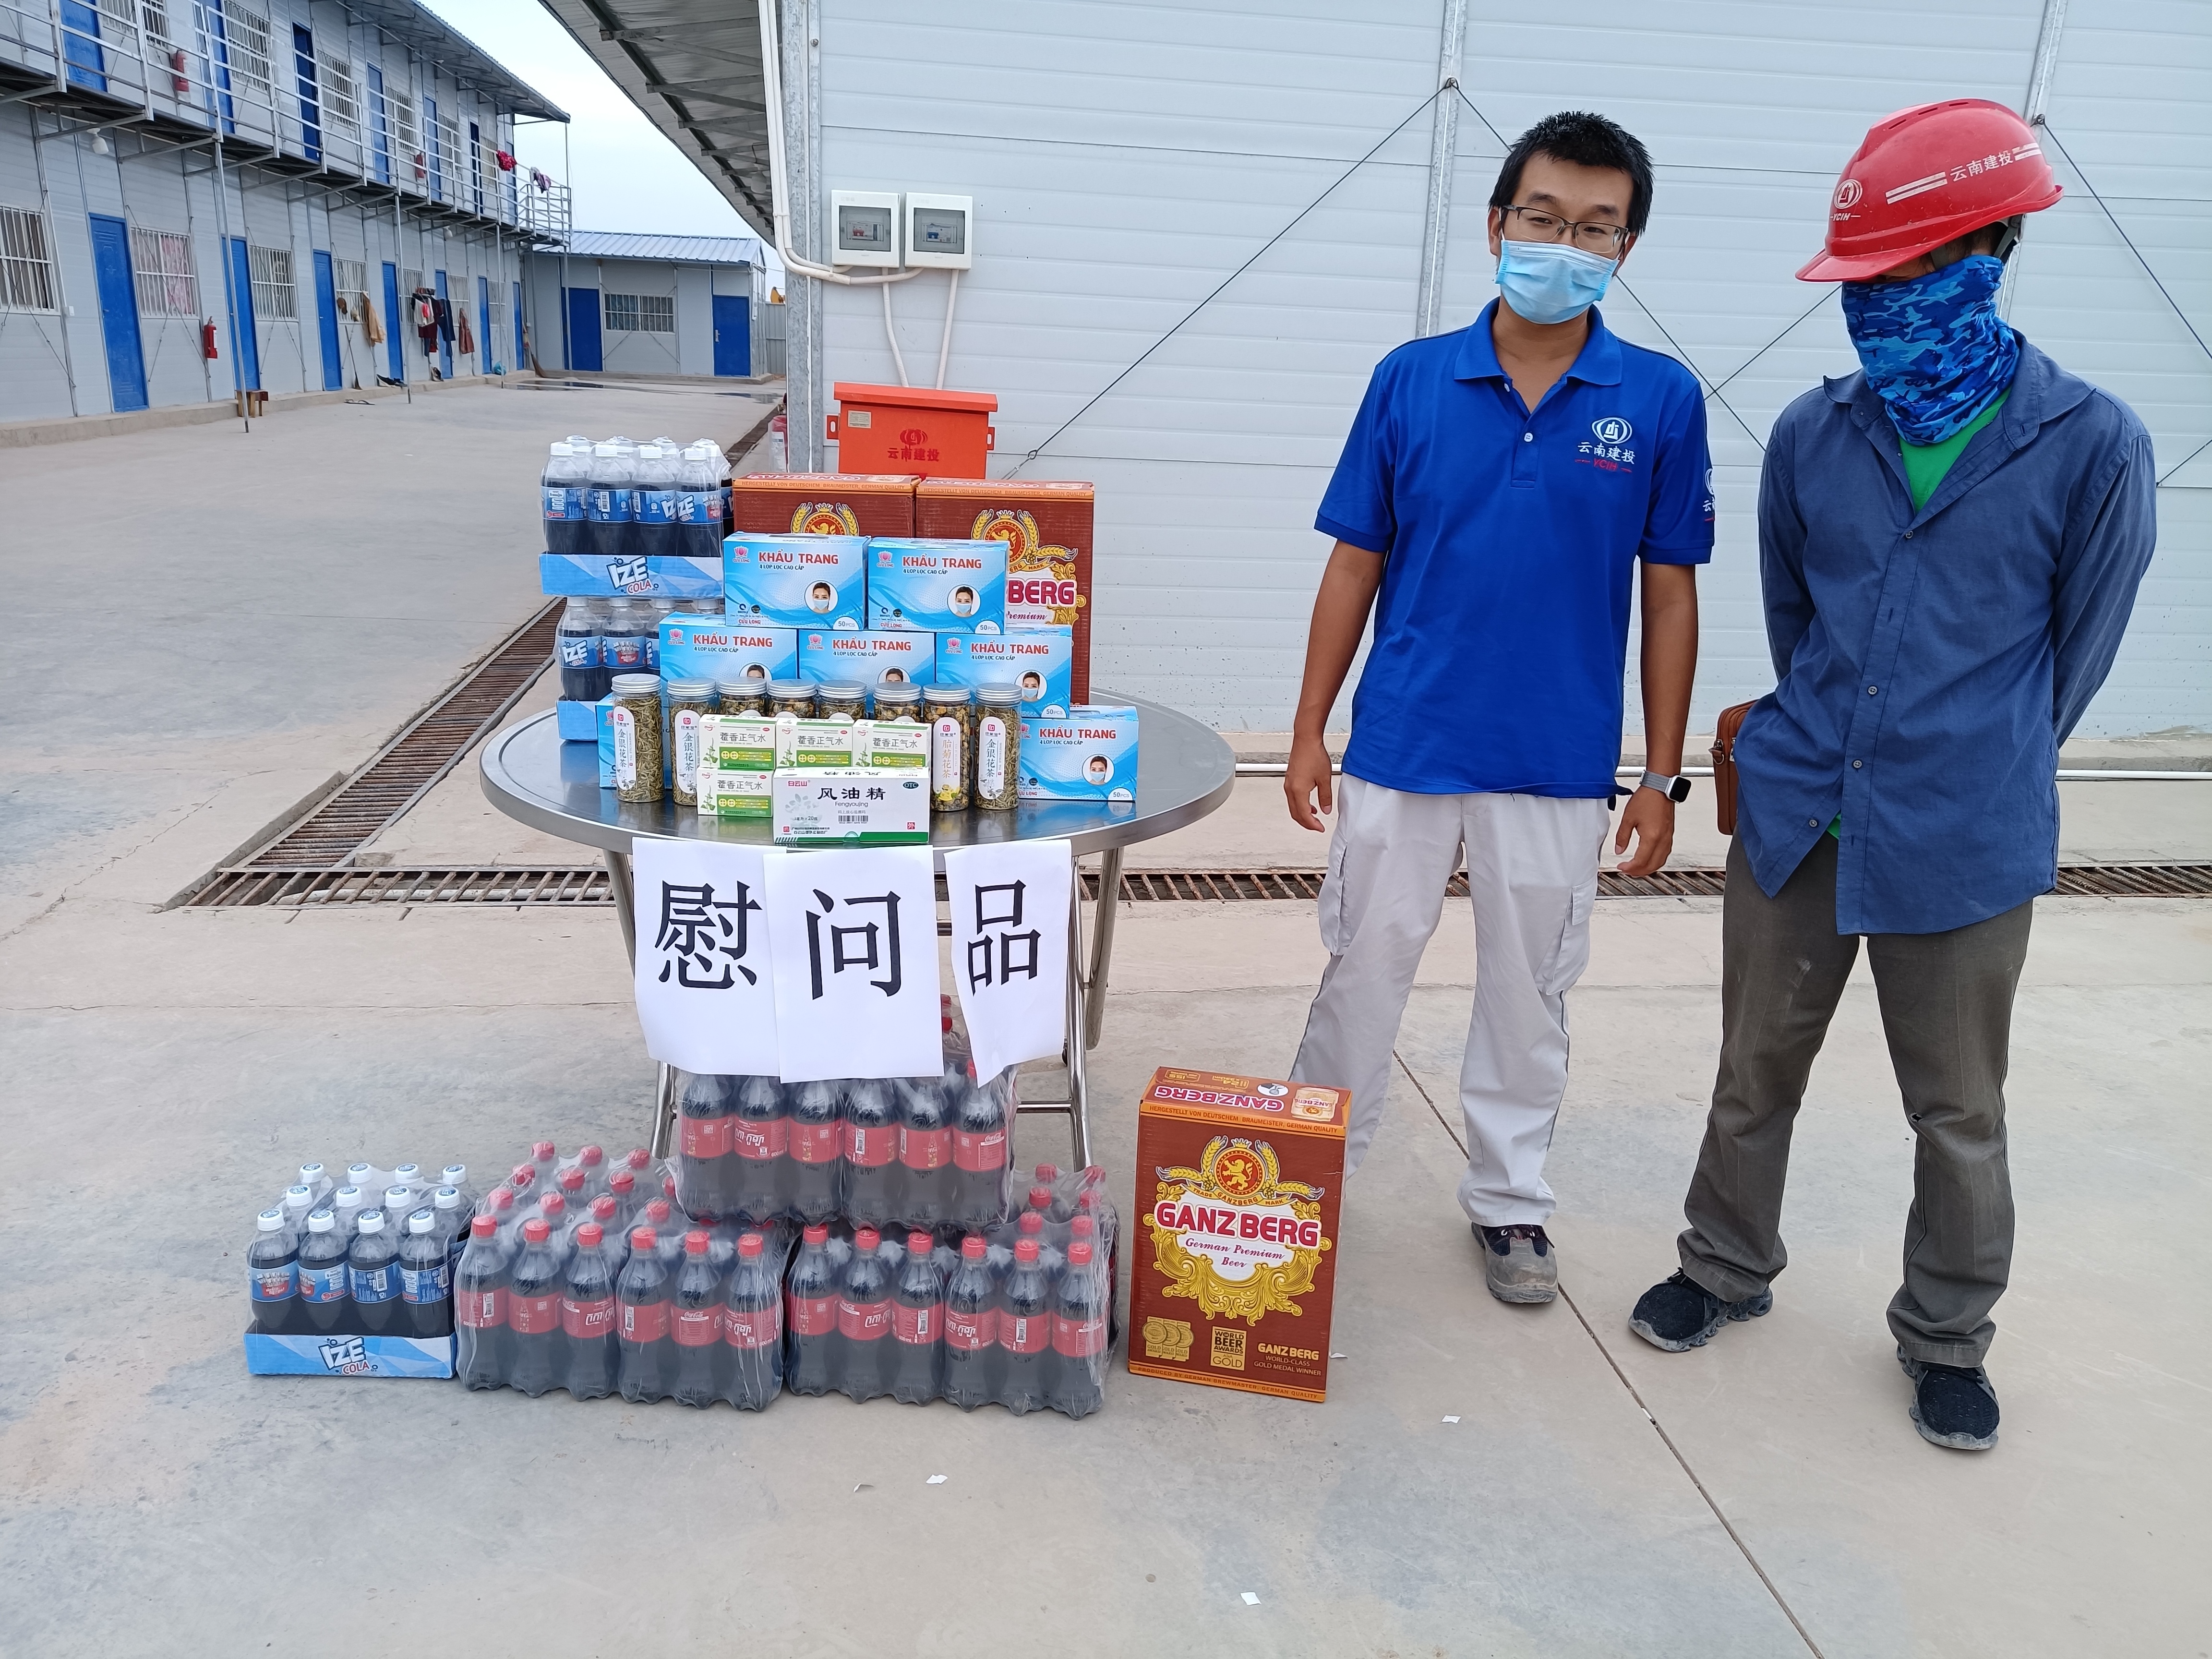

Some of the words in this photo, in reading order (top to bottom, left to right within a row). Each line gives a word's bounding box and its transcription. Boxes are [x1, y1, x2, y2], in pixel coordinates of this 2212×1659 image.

[1950, 150, 2014, 182] 云南建投
[888, 445, 939, 461] 云南建投
[1577, 442, 1635, 464] 云南建投
[759, 549, 793, 563] KHẨU
[798, 553, 838, 564] TRANG
[903, 553, 936, 567] KHẨU
[942, 558, 982, 568] TRANG
[607, 557, 648, 589] IZE
[1010, 563, 1022, 572] ERG
[627, 579, 651, 594] COLA
[1008, 580, 1075, 605] BERG
[693, 632, 727, 646] KHẨU
[733, 636, 773, 648] TRANG
[833, 636, 866, 649] KHẨU
[872, 640, 911, 651] TRANG
[971, 640, 1004, 653] KHẨU
[1010, 644, 1049, 654] TRANG
[562, 640, 588, 663] IZE
[720, 732, 766, 743] 藿香正气水
[1040, 725, 1073, 738] KHẨU
[1079, 729, 1116, 739] TRANG
[797, 735, 843, 745] 藿香正气水
[873, 737, 918, 748] 藿香正气水
[617, 728, 627, 768] 金银花茶
[682, 732, 694, 772] 金银花茶
[942, 739, 951, 779] 胎菊花茶
[986, 739, 997, 778] 金银花茶
[717, 780, 763, 790] 藿香正气水
[817, 787, 886, 800] 风油精
[1150, 1106, 1188, 1116] HERGESTELLT
[1203, 1111, 1238, 1121] DEUTSCHEM
[1242, 1117, 1285, 1128] BRAUMEISTER,
[1193, 1188, 1213, 1198] TRADE
[1217, 1191, 1258, 1205] GANZBERG
[1185, 1238, 1230, 1252] German
[1233, 1245, 1286, 1260] Premium
[1221, 1257, 1247, 1268] Beer
[1214, 1330, 1244, 1340] WORLD
[1213, 1346, 1243, 1354] AWARDS
[1214, 1337, 1243, 1349] BEER
[318, 1337, 366, 1370] IZE
[1265, 1355, 1310, 1367] WORLD-CLASS
[342, 1361, 370, 1375] COLA
[1213, 1357, 1242, 1368] GOLD
[1254, 1361, 1272, 1369] GOLD
[1273, 1364, 1296, 1372] MEDAL
[1296, 1367, 1322, 1376] WINNER
[1138, 1367, 1173, 1377] PRODUCED
[1184, 1374, 1211, 1382] GERMAN
[1213, 1379, 1260, 1390] BREWMASTER,
[1262, 1386, 1288, 1394] GERMAN
[1291, 1390, 1318, 1399] QUALITY
